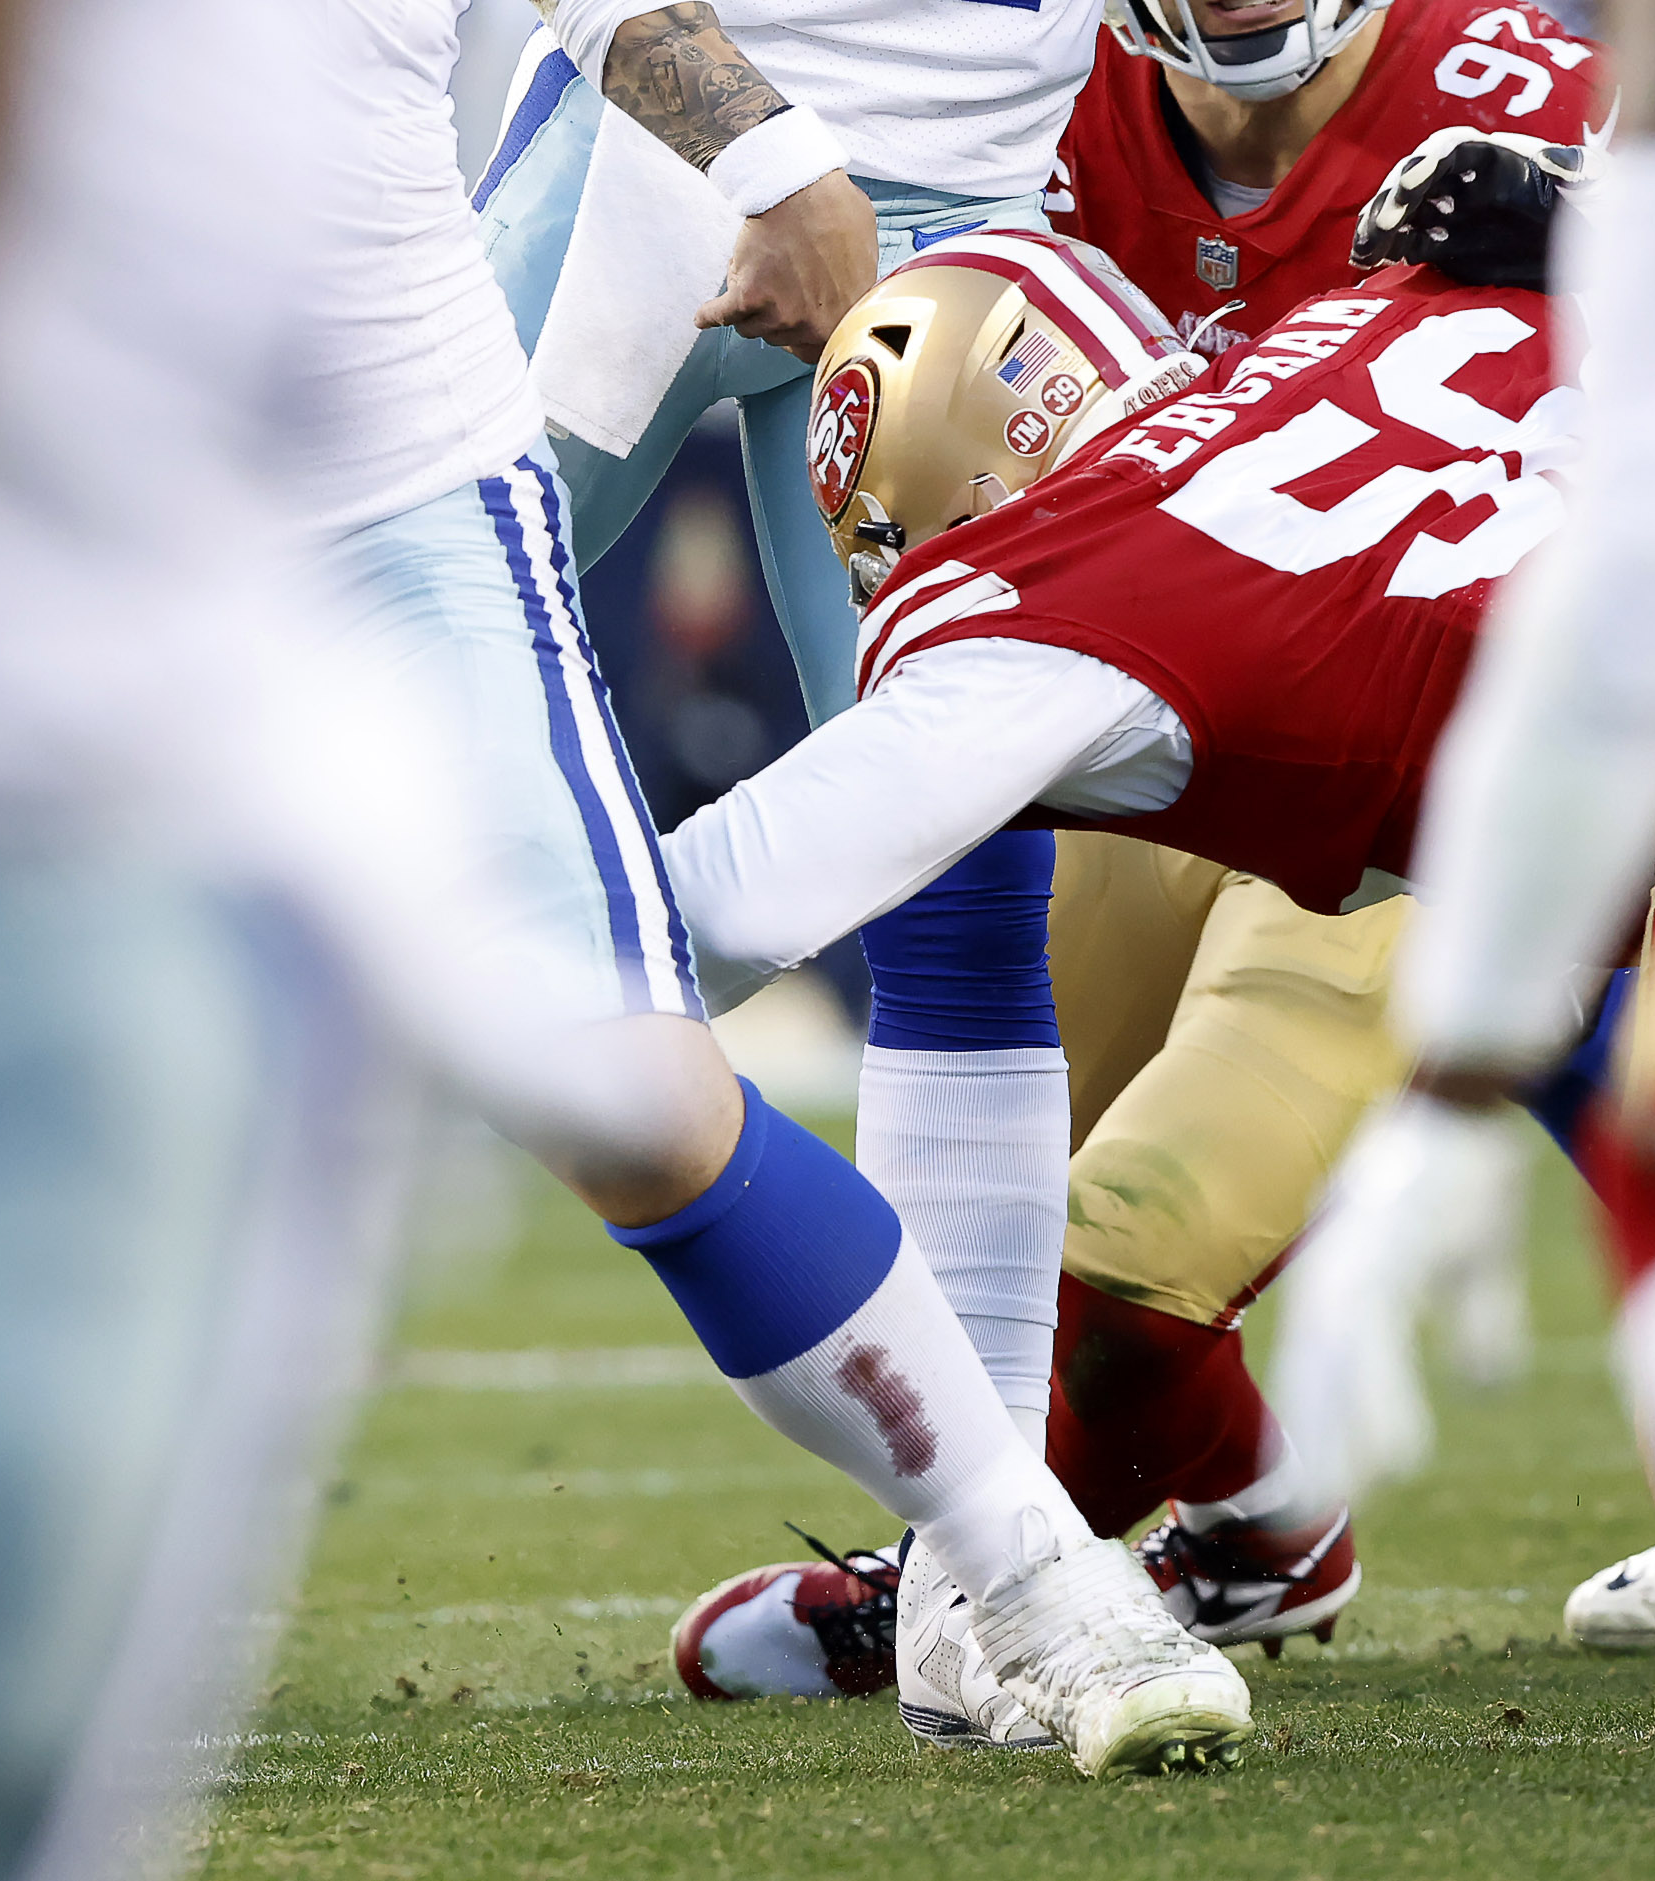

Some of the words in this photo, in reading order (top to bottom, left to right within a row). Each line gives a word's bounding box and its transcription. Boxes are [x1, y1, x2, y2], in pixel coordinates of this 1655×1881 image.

[1433, 7, 1594, 118] 97
[1010, 412, 1047, 454] JM
[1043, 376, 1083, 415] 39
[1156, 307, 1588, 600] 56
